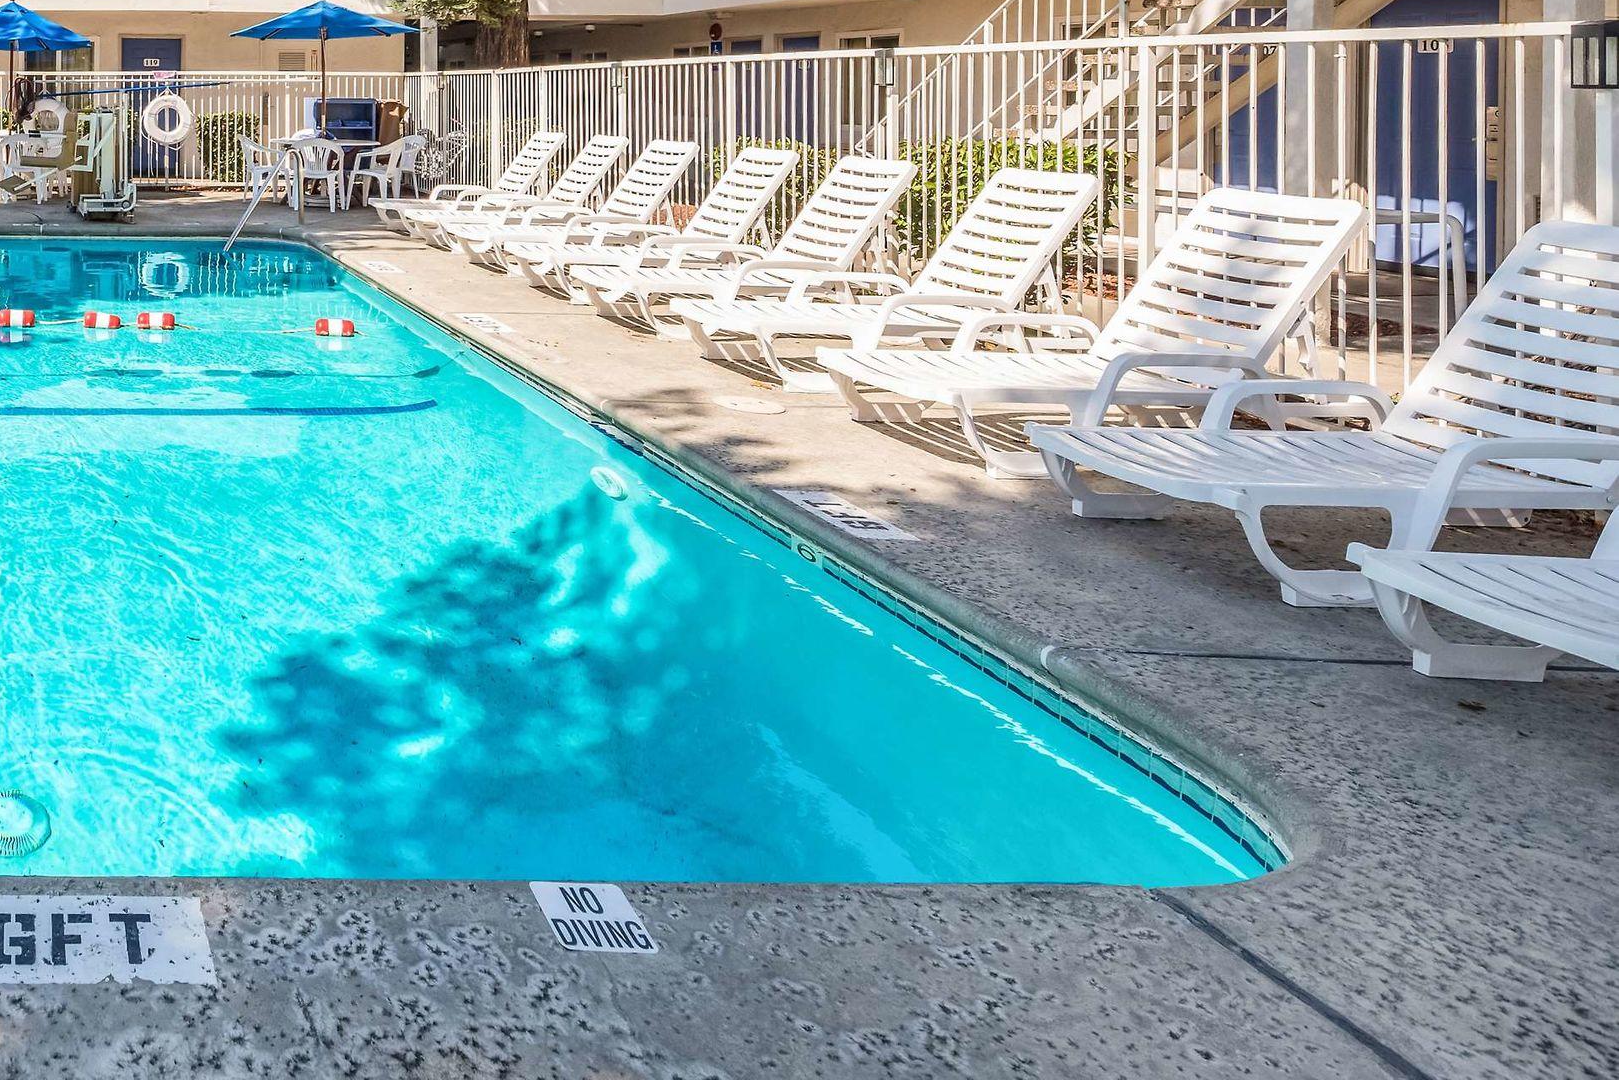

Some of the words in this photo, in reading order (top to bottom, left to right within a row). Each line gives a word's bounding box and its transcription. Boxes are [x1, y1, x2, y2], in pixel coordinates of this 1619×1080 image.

[1262, 45, 1277, 55] 07
[796, 542, 817, 563] 6
[558, 886, 604, 915] NO
[550, 918, 654, 950] DIVING
